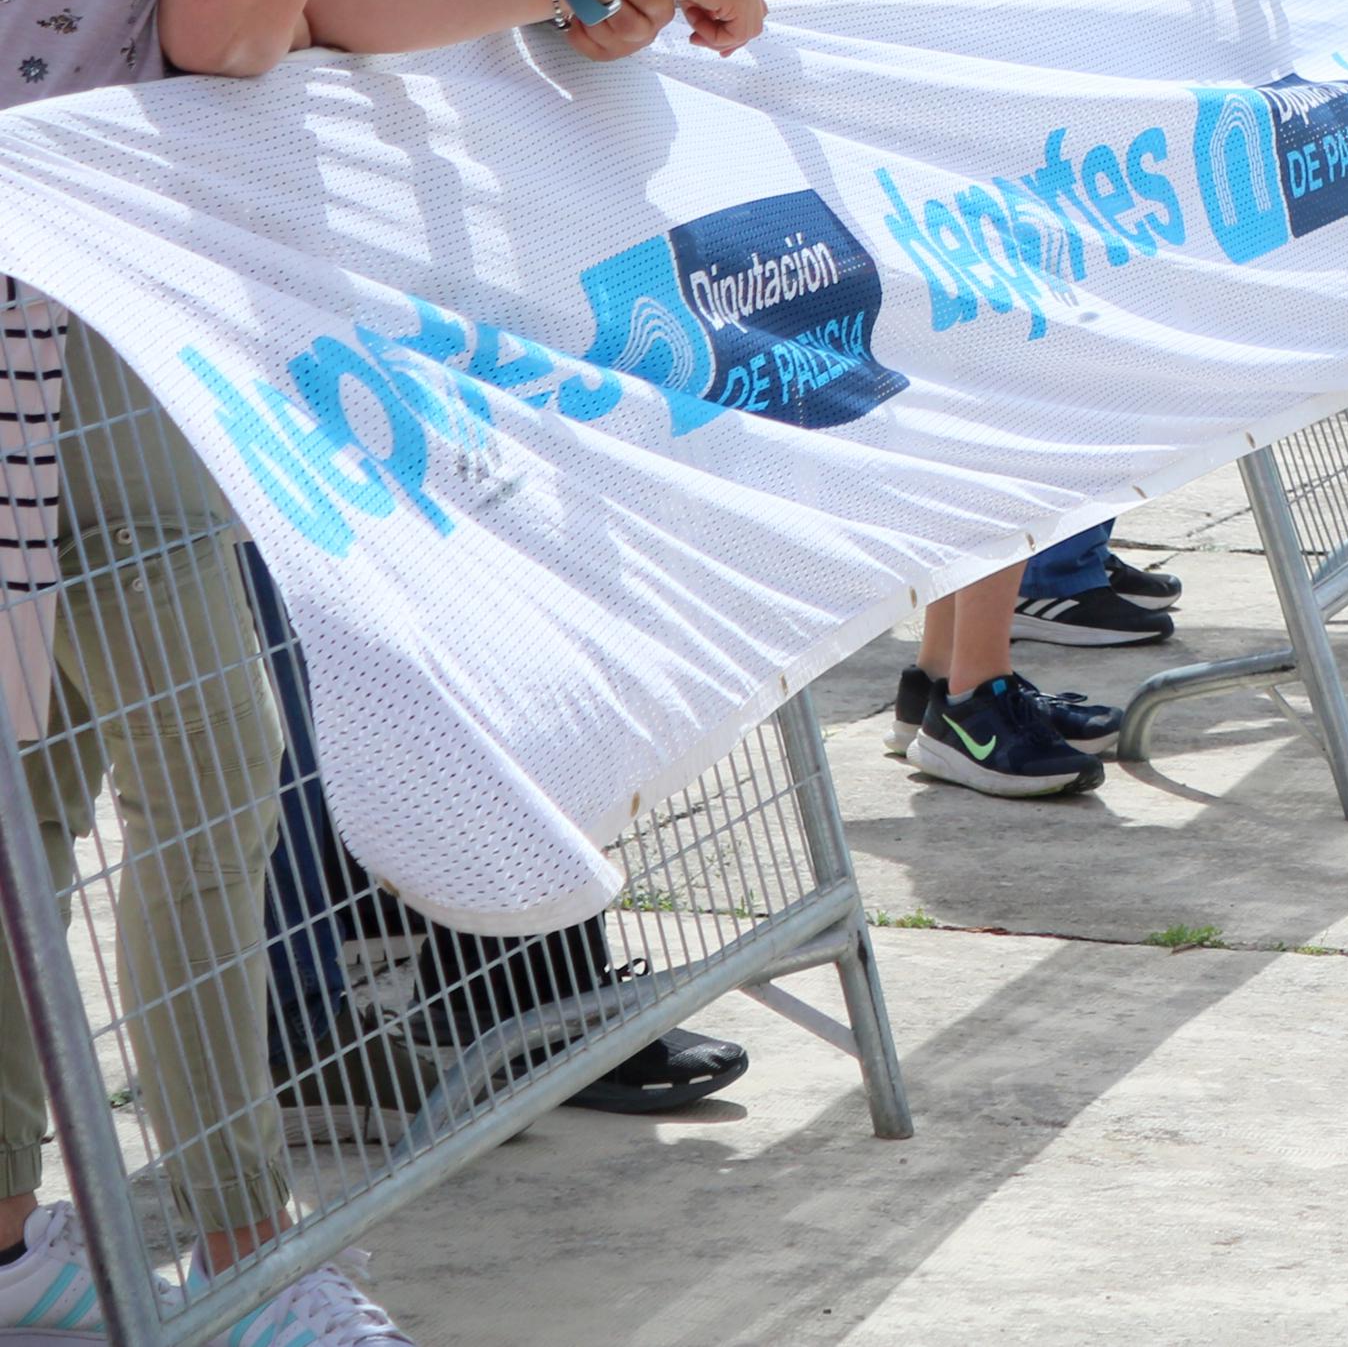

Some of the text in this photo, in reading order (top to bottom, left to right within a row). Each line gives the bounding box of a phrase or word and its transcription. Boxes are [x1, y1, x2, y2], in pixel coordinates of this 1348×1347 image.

[1287, 142, 1324, 199] DE
[690, 232, 839, 333] Diputación
[717, 310, 871, 412] DE PALENCIA
